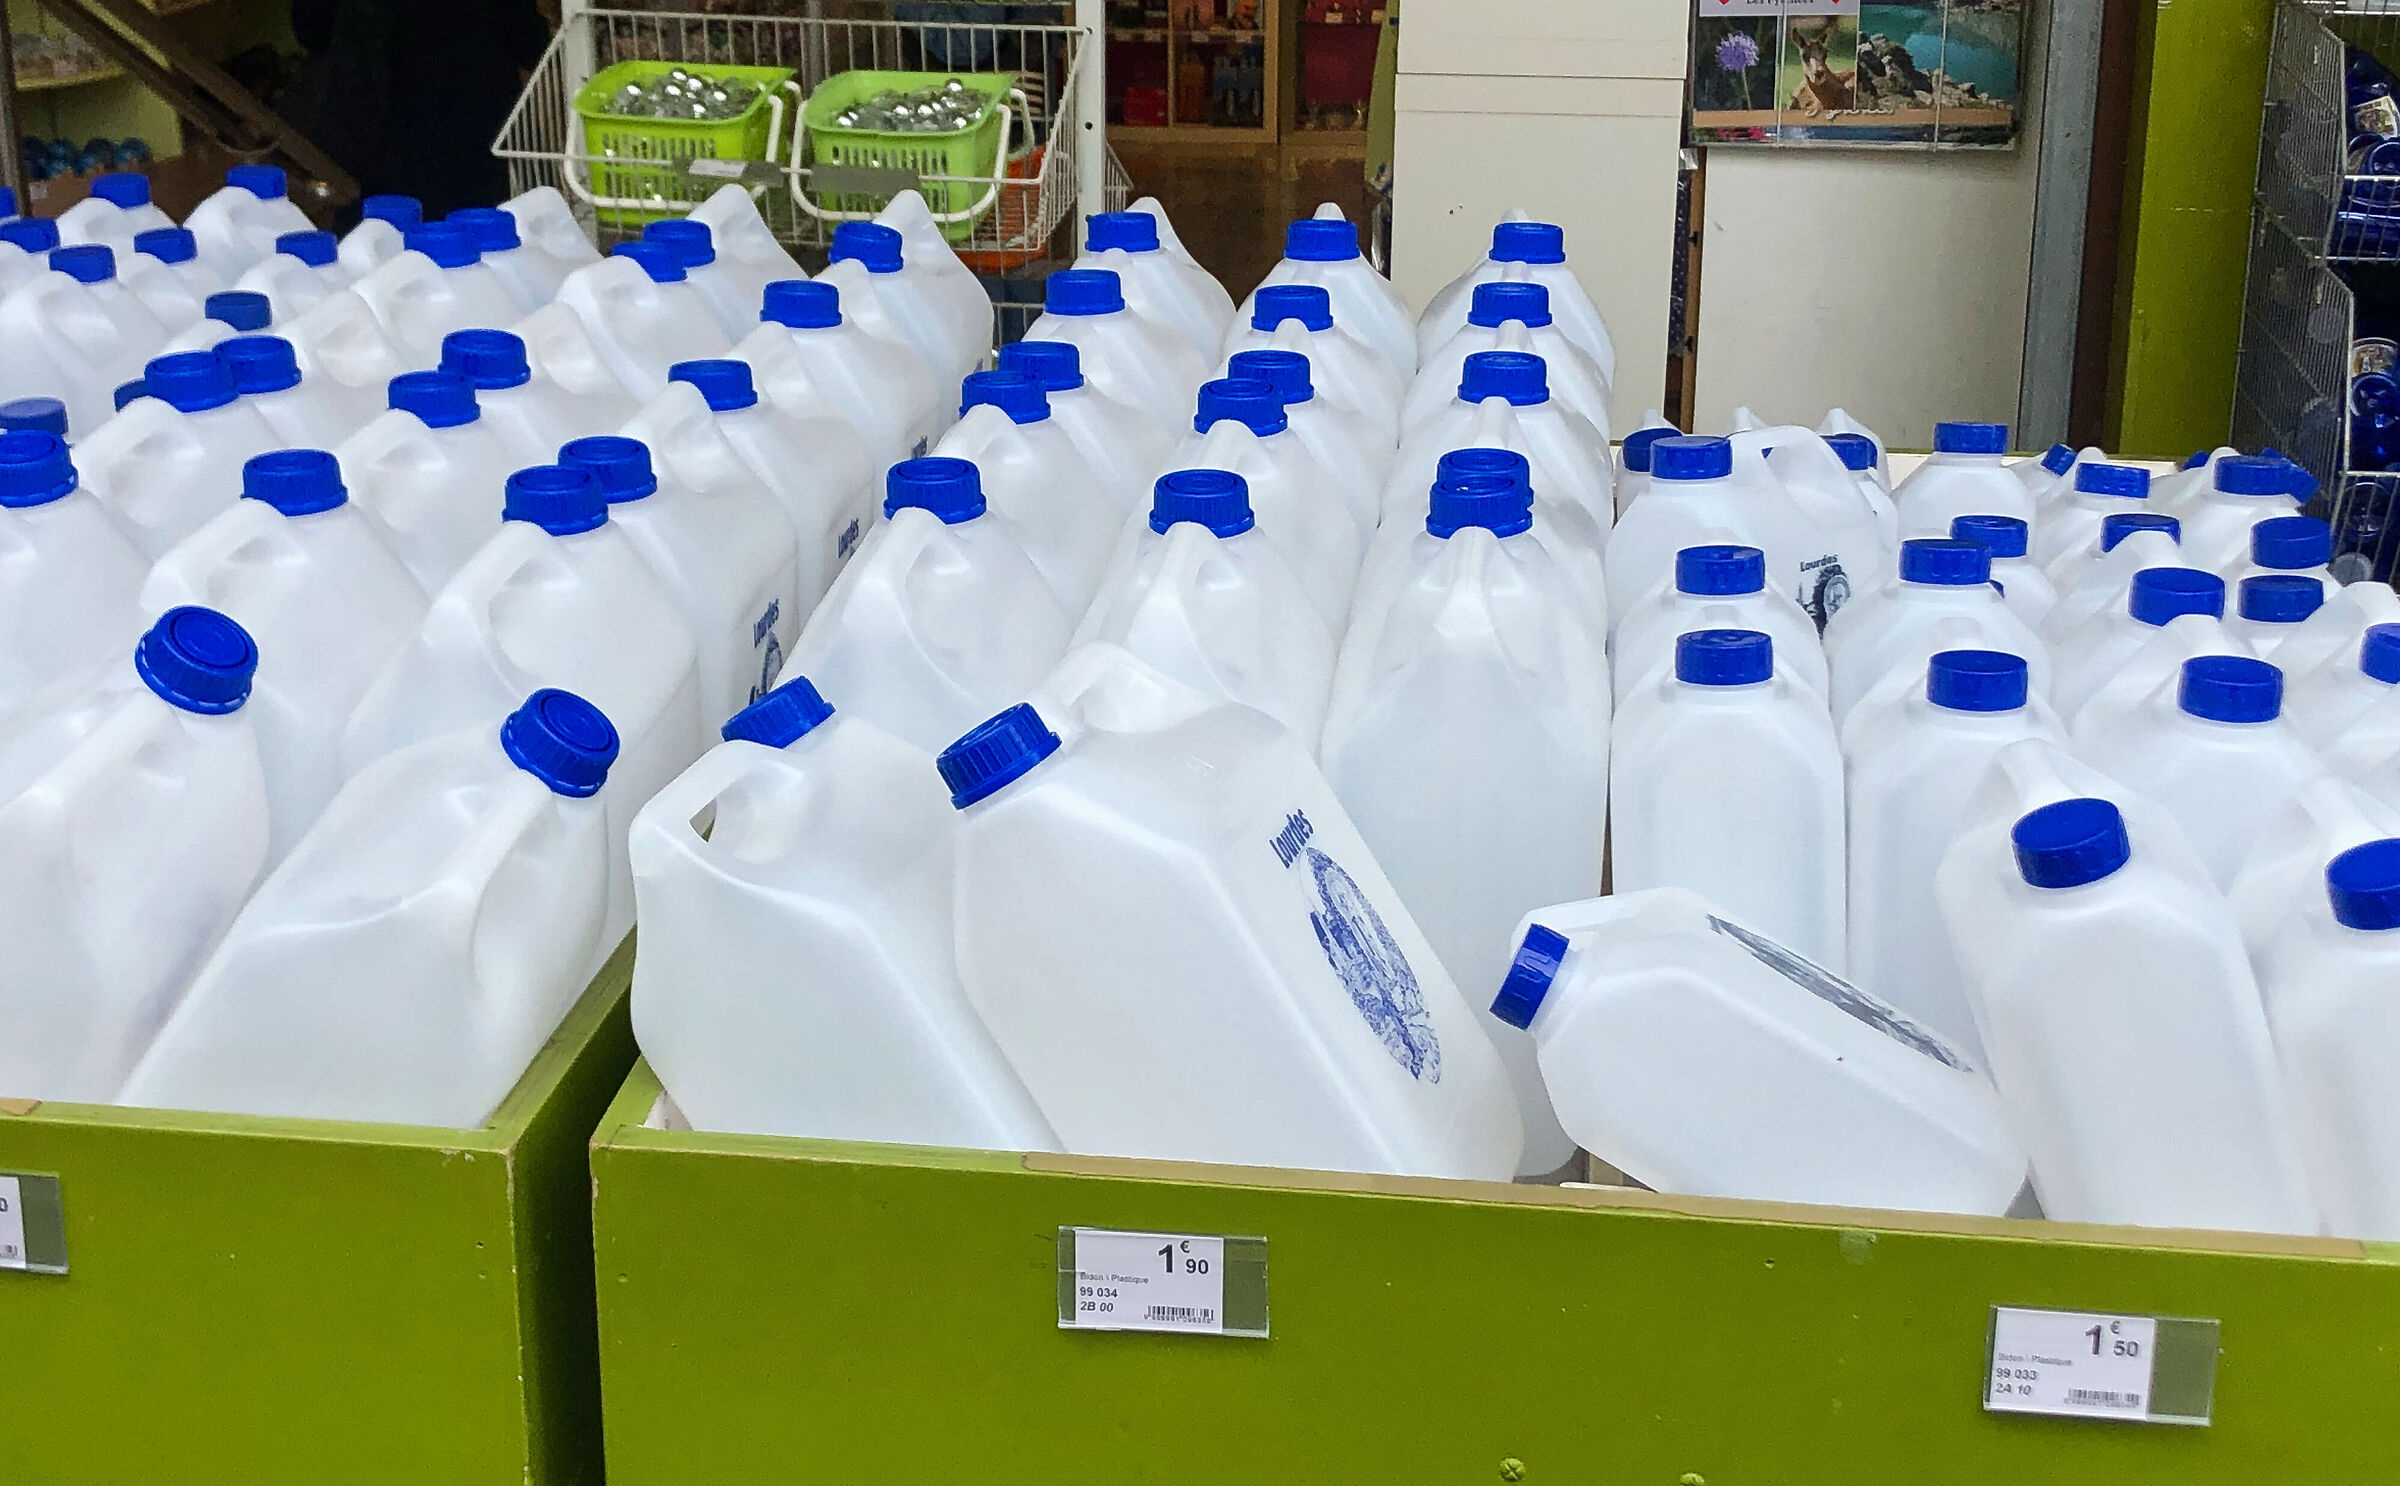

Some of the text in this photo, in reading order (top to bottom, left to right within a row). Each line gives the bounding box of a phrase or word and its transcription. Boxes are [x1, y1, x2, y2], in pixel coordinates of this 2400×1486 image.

[1800, 553, 1838, 572] Lourdes
[1268, 808, 1314, 869] Lourdes
[1080, 1286, 1118, 1298] 99 034
[1080, 1301, 1114, 1312] 2B 00
[1996, 1367, 2038, 1380] 99 033
[1996, 1382, 2032, 1395] 2A 10
